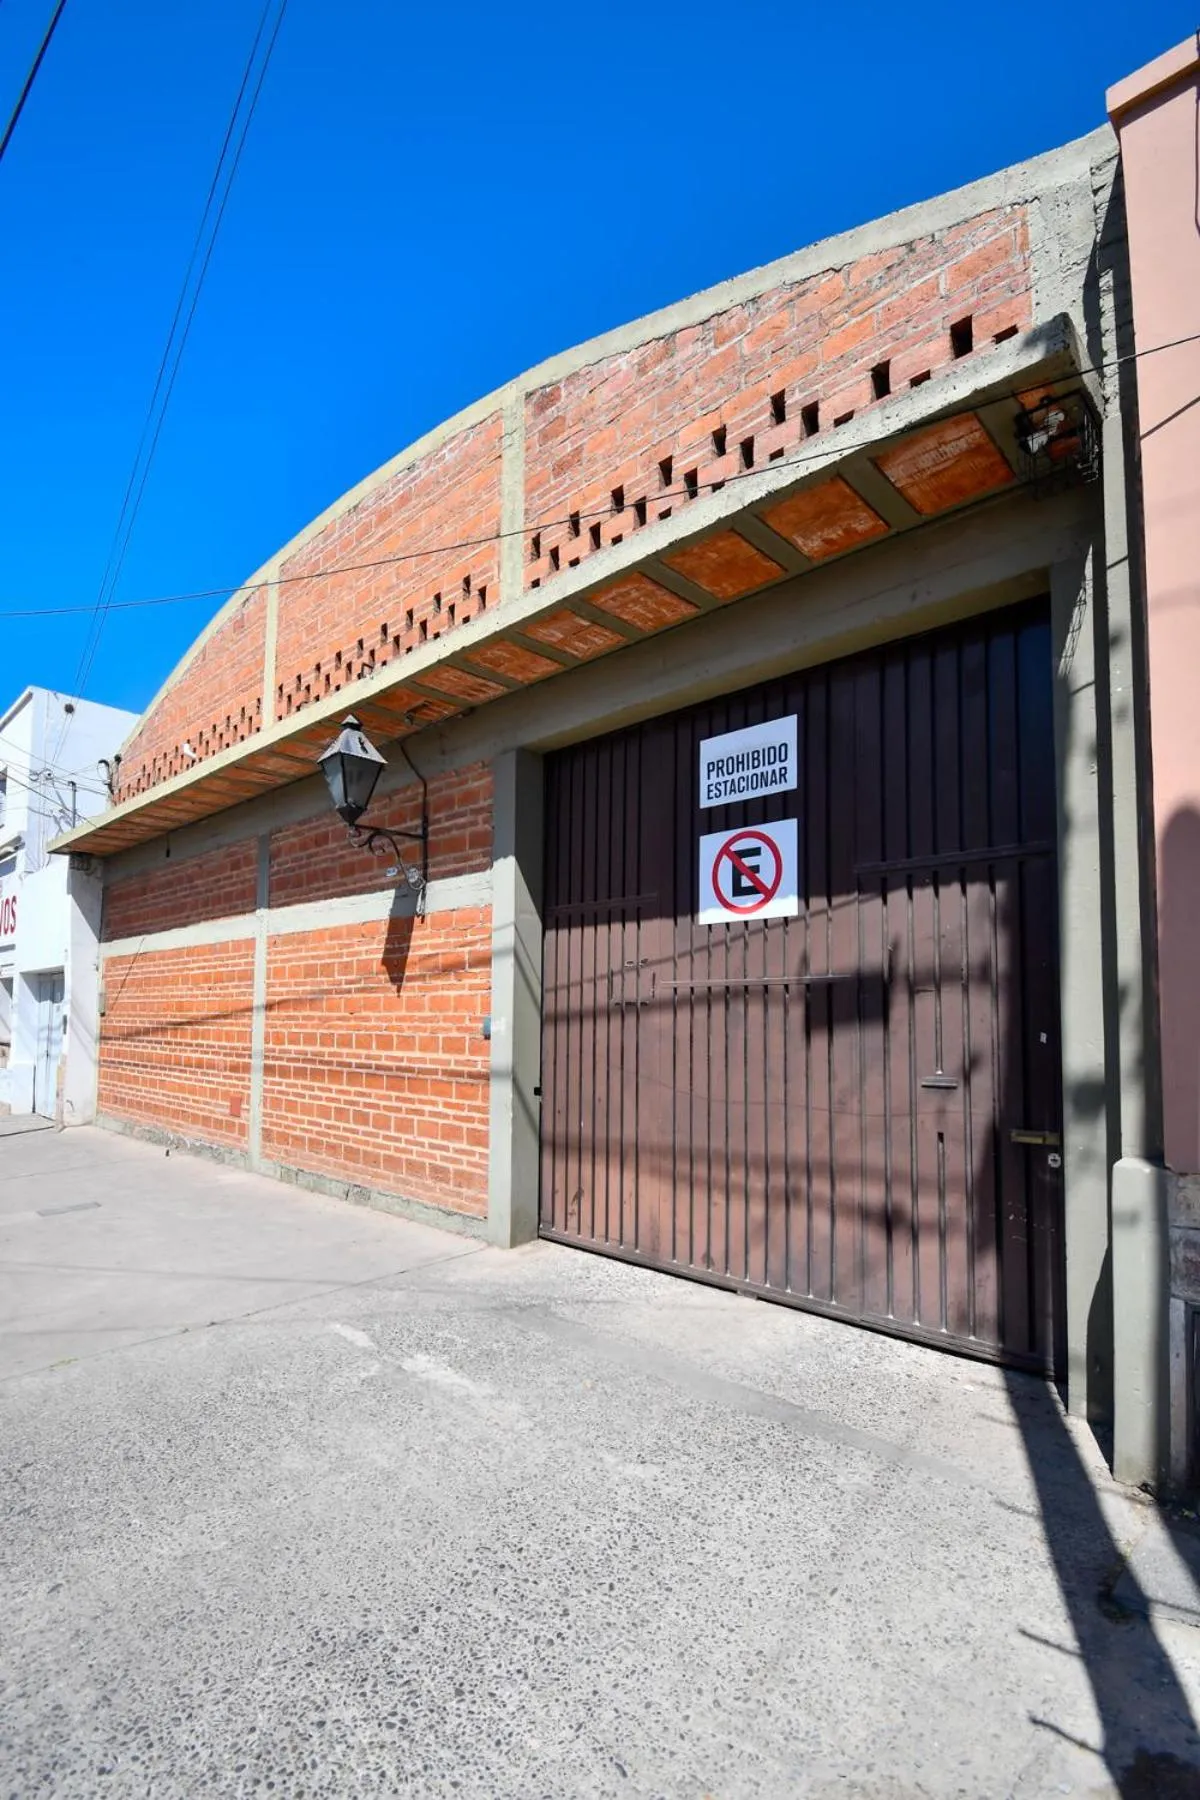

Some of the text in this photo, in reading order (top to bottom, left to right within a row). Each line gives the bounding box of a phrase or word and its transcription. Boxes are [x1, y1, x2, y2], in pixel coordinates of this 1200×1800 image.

[707, 742, 789, 780] PROHIBIDO
[707, 766, 788, 800] ESTACIONAR
[732, 846, 762, 898] E
